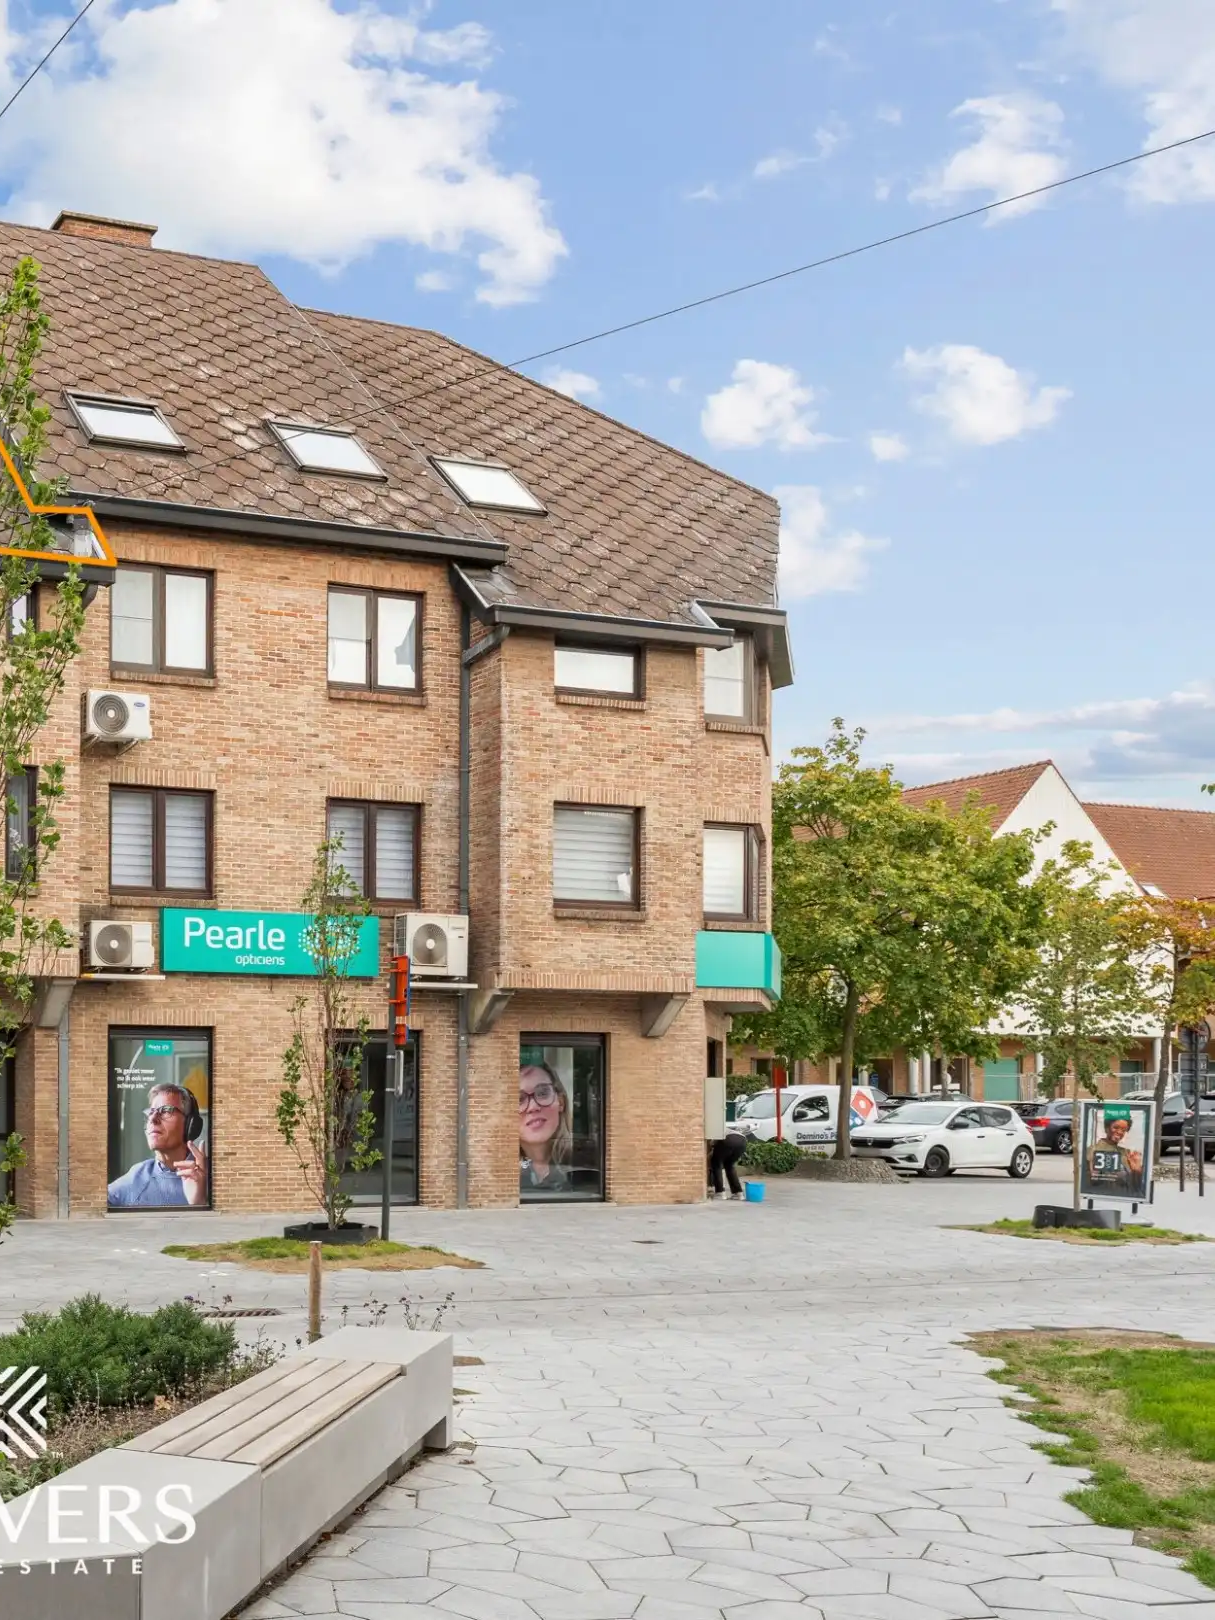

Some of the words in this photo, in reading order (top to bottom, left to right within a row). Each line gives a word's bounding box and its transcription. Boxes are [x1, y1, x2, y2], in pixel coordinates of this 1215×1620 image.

[183, 916, 286, 951] Pearle
[235, 954, 286, 966] opticiens
[796, 1132, 829, 1140] Domino's
[1094, 1152, 1105, 1169] 3
[1112, 1154, 1119, 1170] 1
